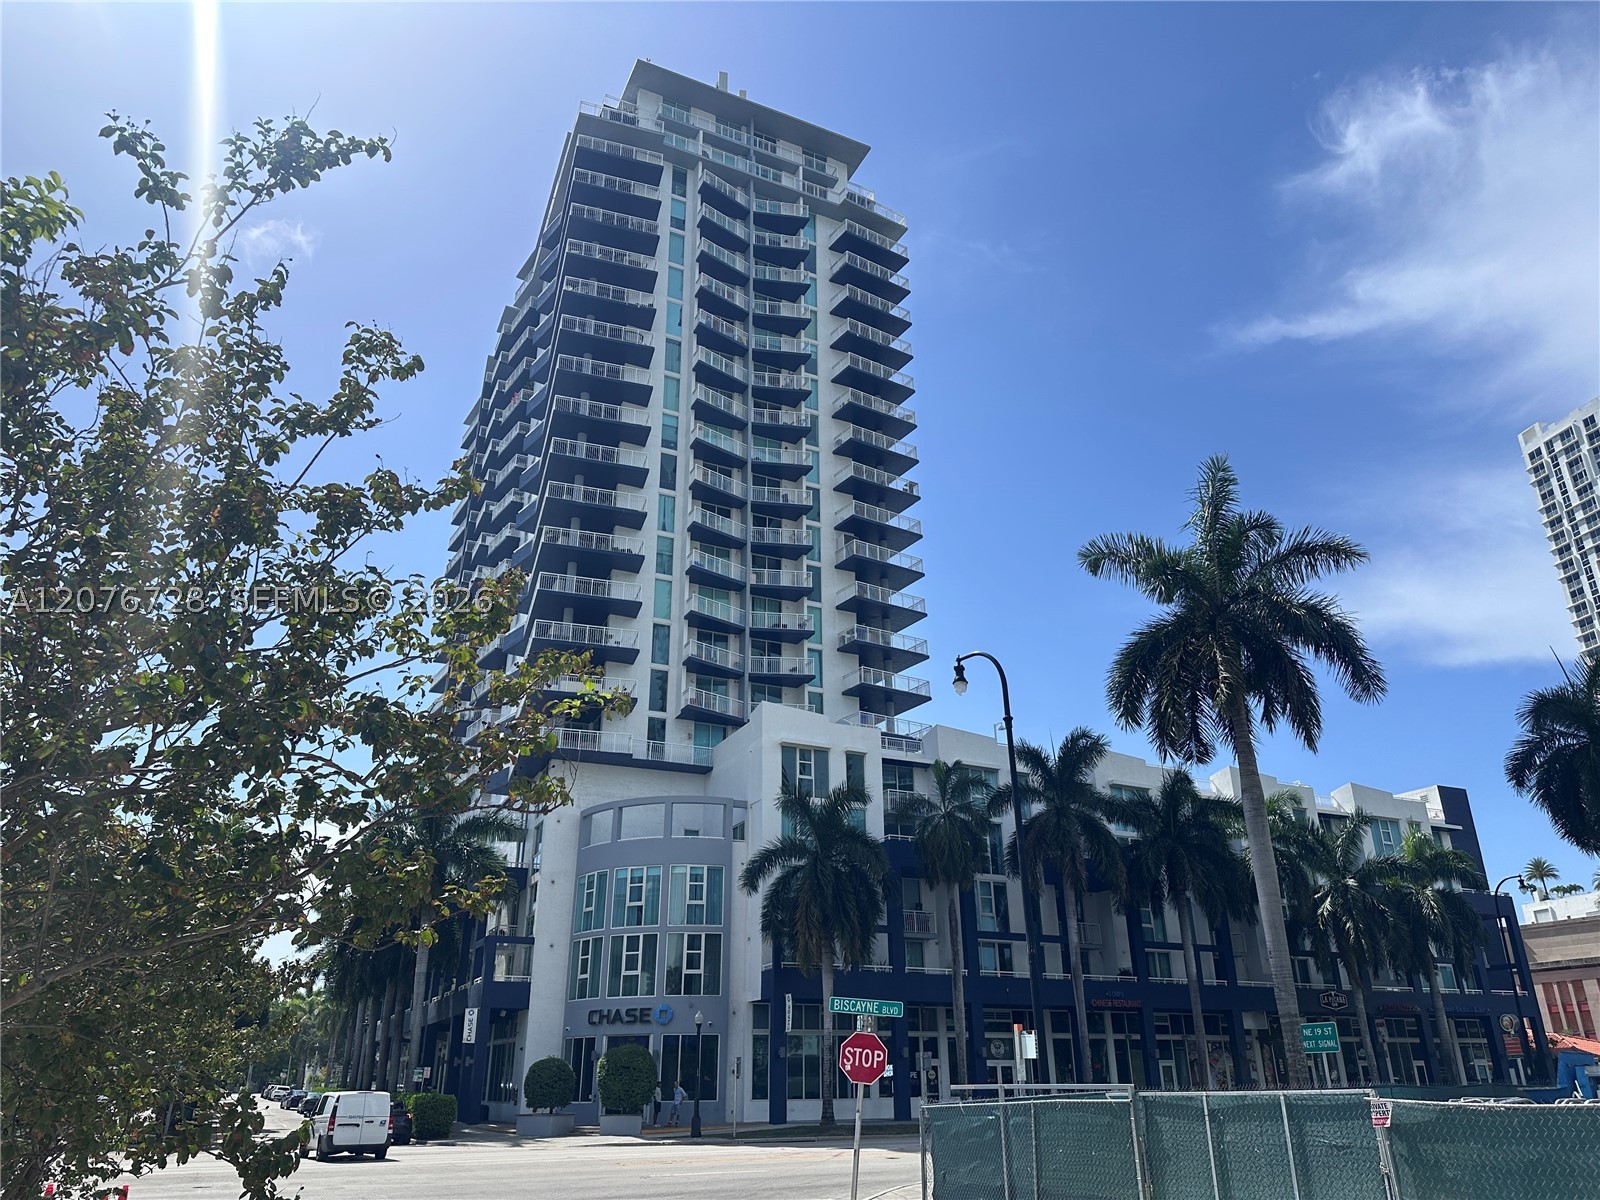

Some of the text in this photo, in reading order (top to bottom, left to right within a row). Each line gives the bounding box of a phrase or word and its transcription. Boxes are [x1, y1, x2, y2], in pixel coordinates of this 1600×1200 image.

[833, 999, 899, 1015] BISCAYNE BLVD
[587, 1008, 652, 1025] CHASE
[466, 1018, 474, 1042] CHASE
[1302, 1027, 1332, 1036] NE 19 ST
[1318, 1039, 1338, 1048] SIGNAL
[843, 1047, 884, 1068] STOP
